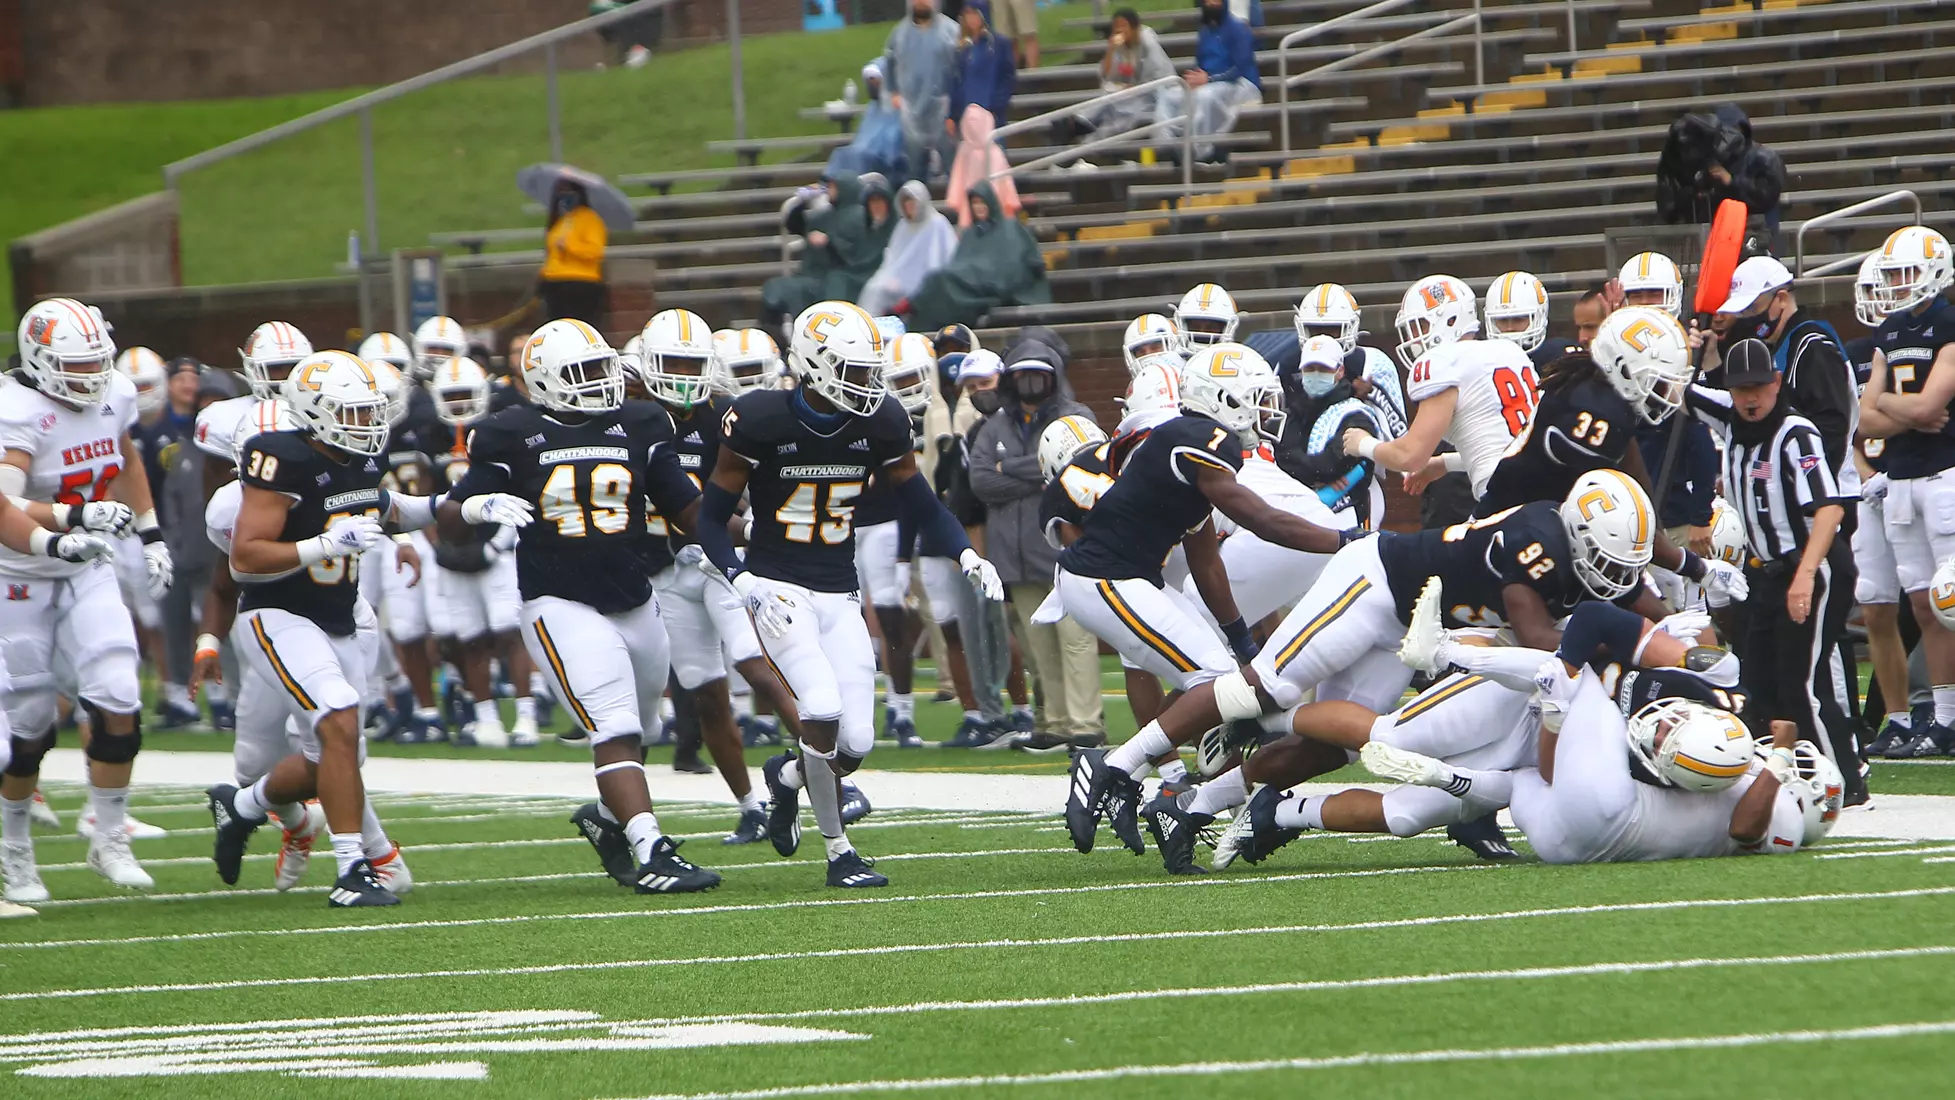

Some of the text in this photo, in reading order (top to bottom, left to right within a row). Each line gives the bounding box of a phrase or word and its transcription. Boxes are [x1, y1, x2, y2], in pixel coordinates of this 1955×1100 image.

[804, 312, 843, 343] C
[1621, 319, 1666, 353] C
[298, 361, 333, 392] C
[1209, 351, 1243, 377] C
[1413, 359, 1430, 383] 81
[1207, 427, 1228, 450] 7
[1572, 411, 1610, 447] 33
[62, 437, 115, 466] MERCER
[247, 450, 279, 482] 38
[541, 448, 627, 462] CHATTANOOGA
[782, 466, 864, 477] CHATTANOOGA
[539, 463, 632, 537] 49
[775, 482, 864, 544] 45
[1577, 488, 1616, 521] C
[1756, 496, 1769, 512] L
[1517, 541, 1556, 581] 92
[1156, 811, 1170, 841] adidas
